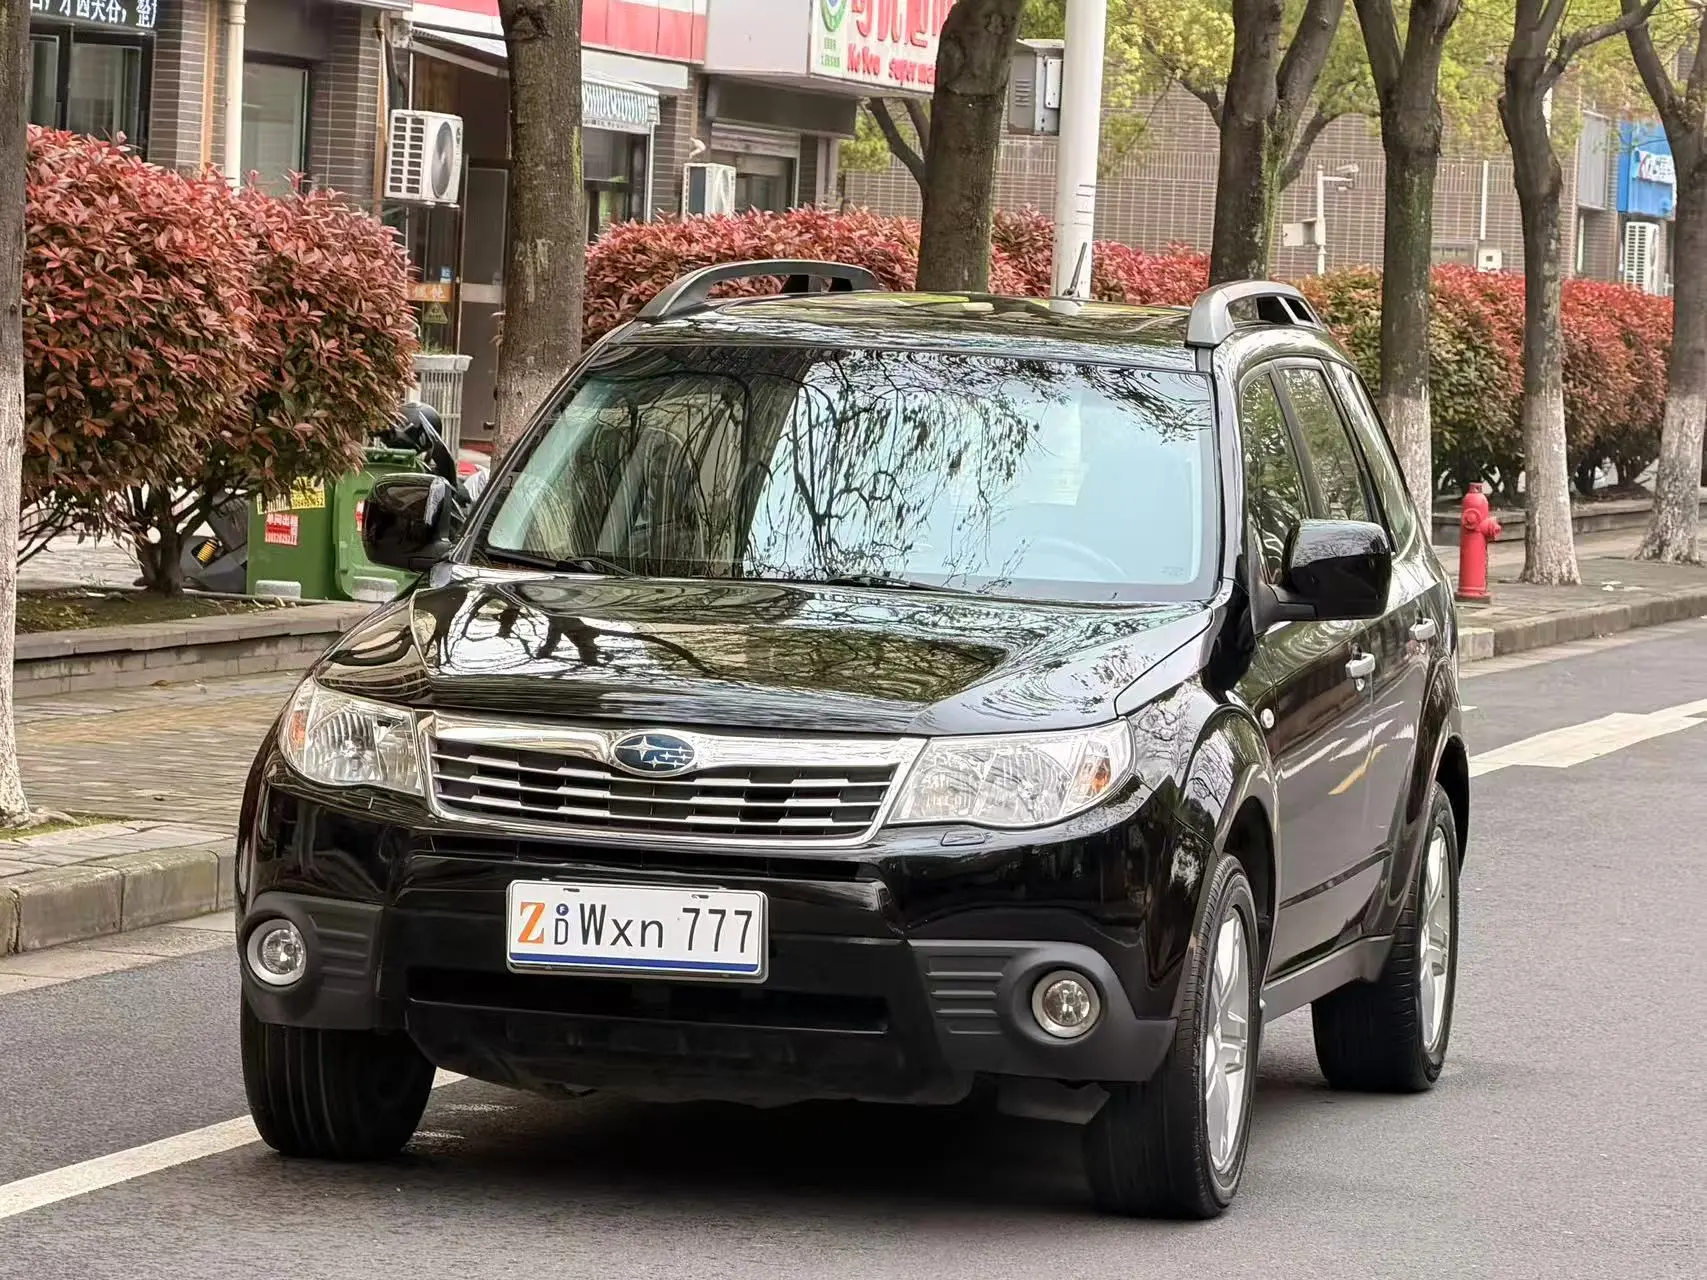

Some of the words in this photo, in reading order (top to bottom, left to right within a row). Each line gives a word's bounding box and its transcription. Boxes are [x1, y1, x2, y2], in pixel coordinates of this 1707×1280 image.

[517, 902, 545, 944] Z
[554, 918, 569, 945] D
[579, 903, 664, 948] Wxn
[682, 907, 753, 953] 777
